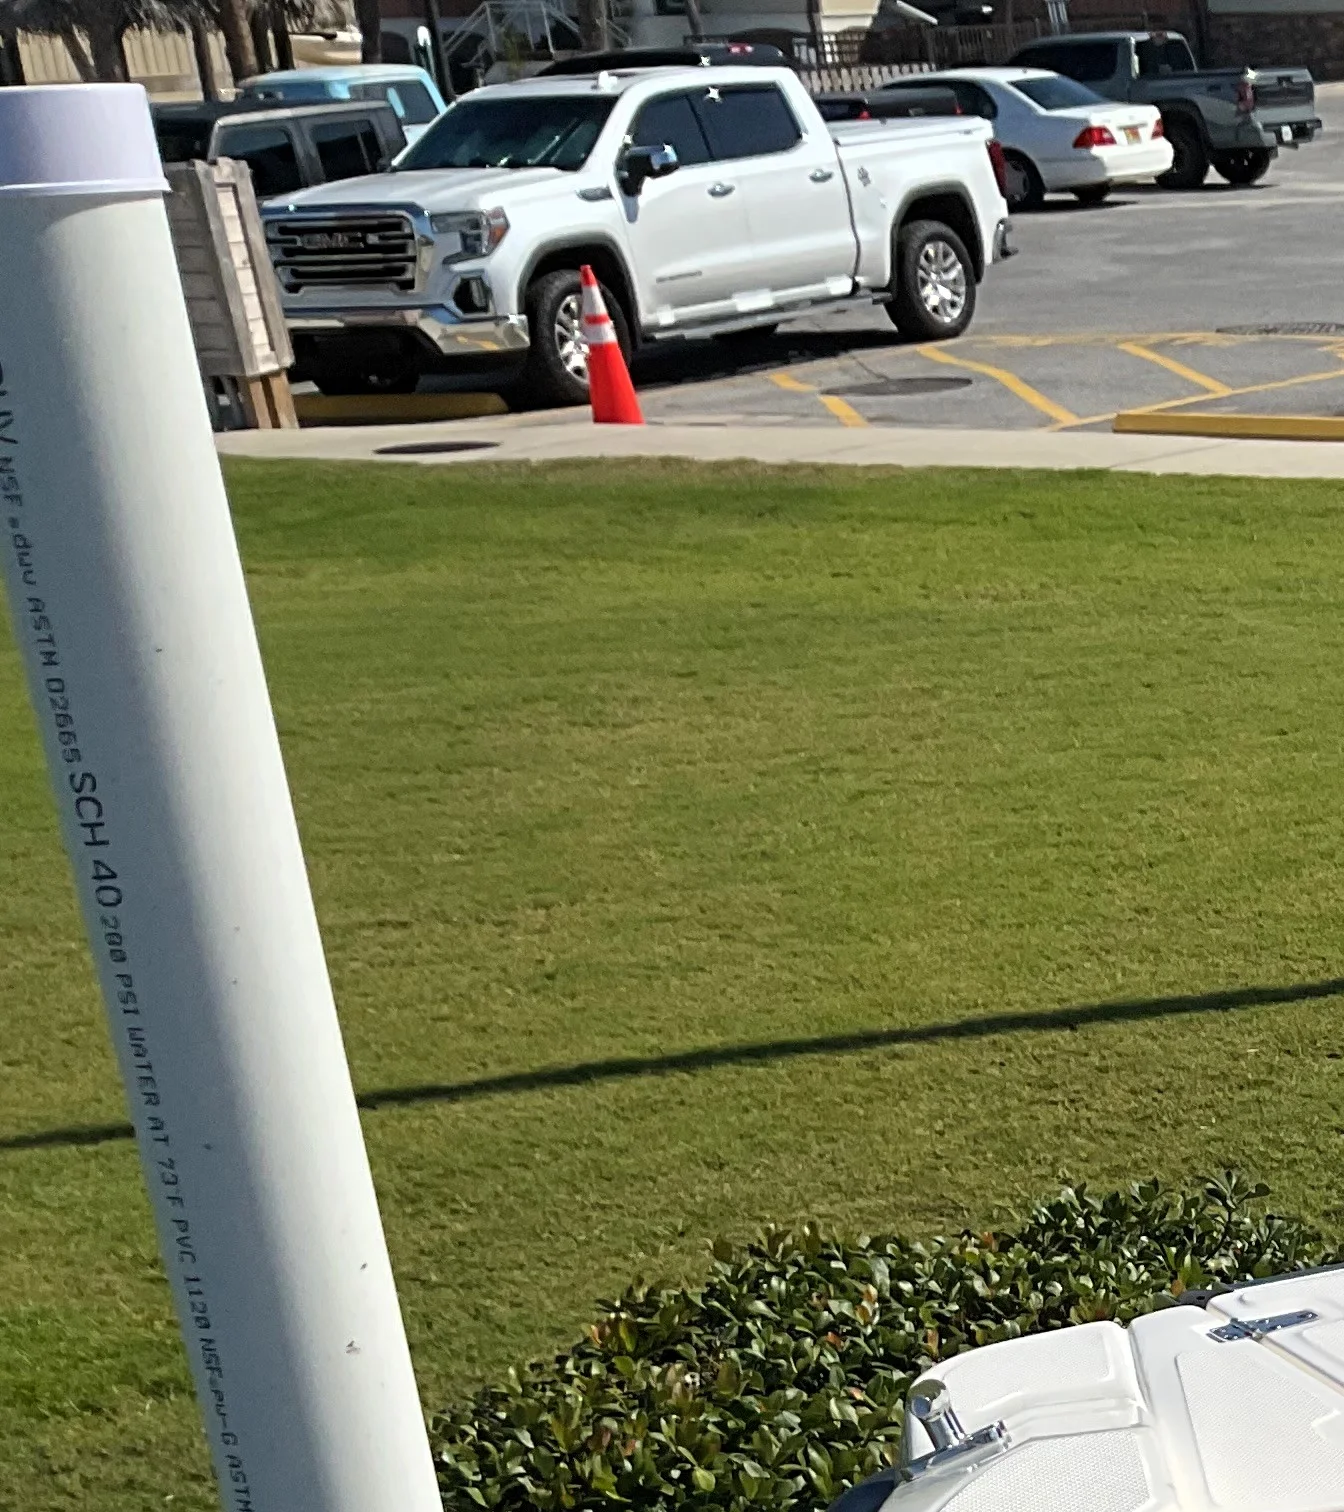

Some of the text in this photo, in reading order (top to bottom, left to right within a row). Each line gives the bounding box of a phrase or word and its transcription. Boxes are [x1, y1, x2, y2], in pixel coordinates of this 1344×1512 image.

[26, 597, 60, 667] ASTM
[68, 772, 110, 847] SCH
[91, 859, 123, 908] 40
[115, 973, 140, 1016] PSI
[127, 1027, 161, 1107] WATER
[147, 1116, 170, 1146] AT
[171, 1218, 197, 1264] PVC
[184, 1276, 212, 1330] 1120
[225, 1454, 255, 1512] ASTM
